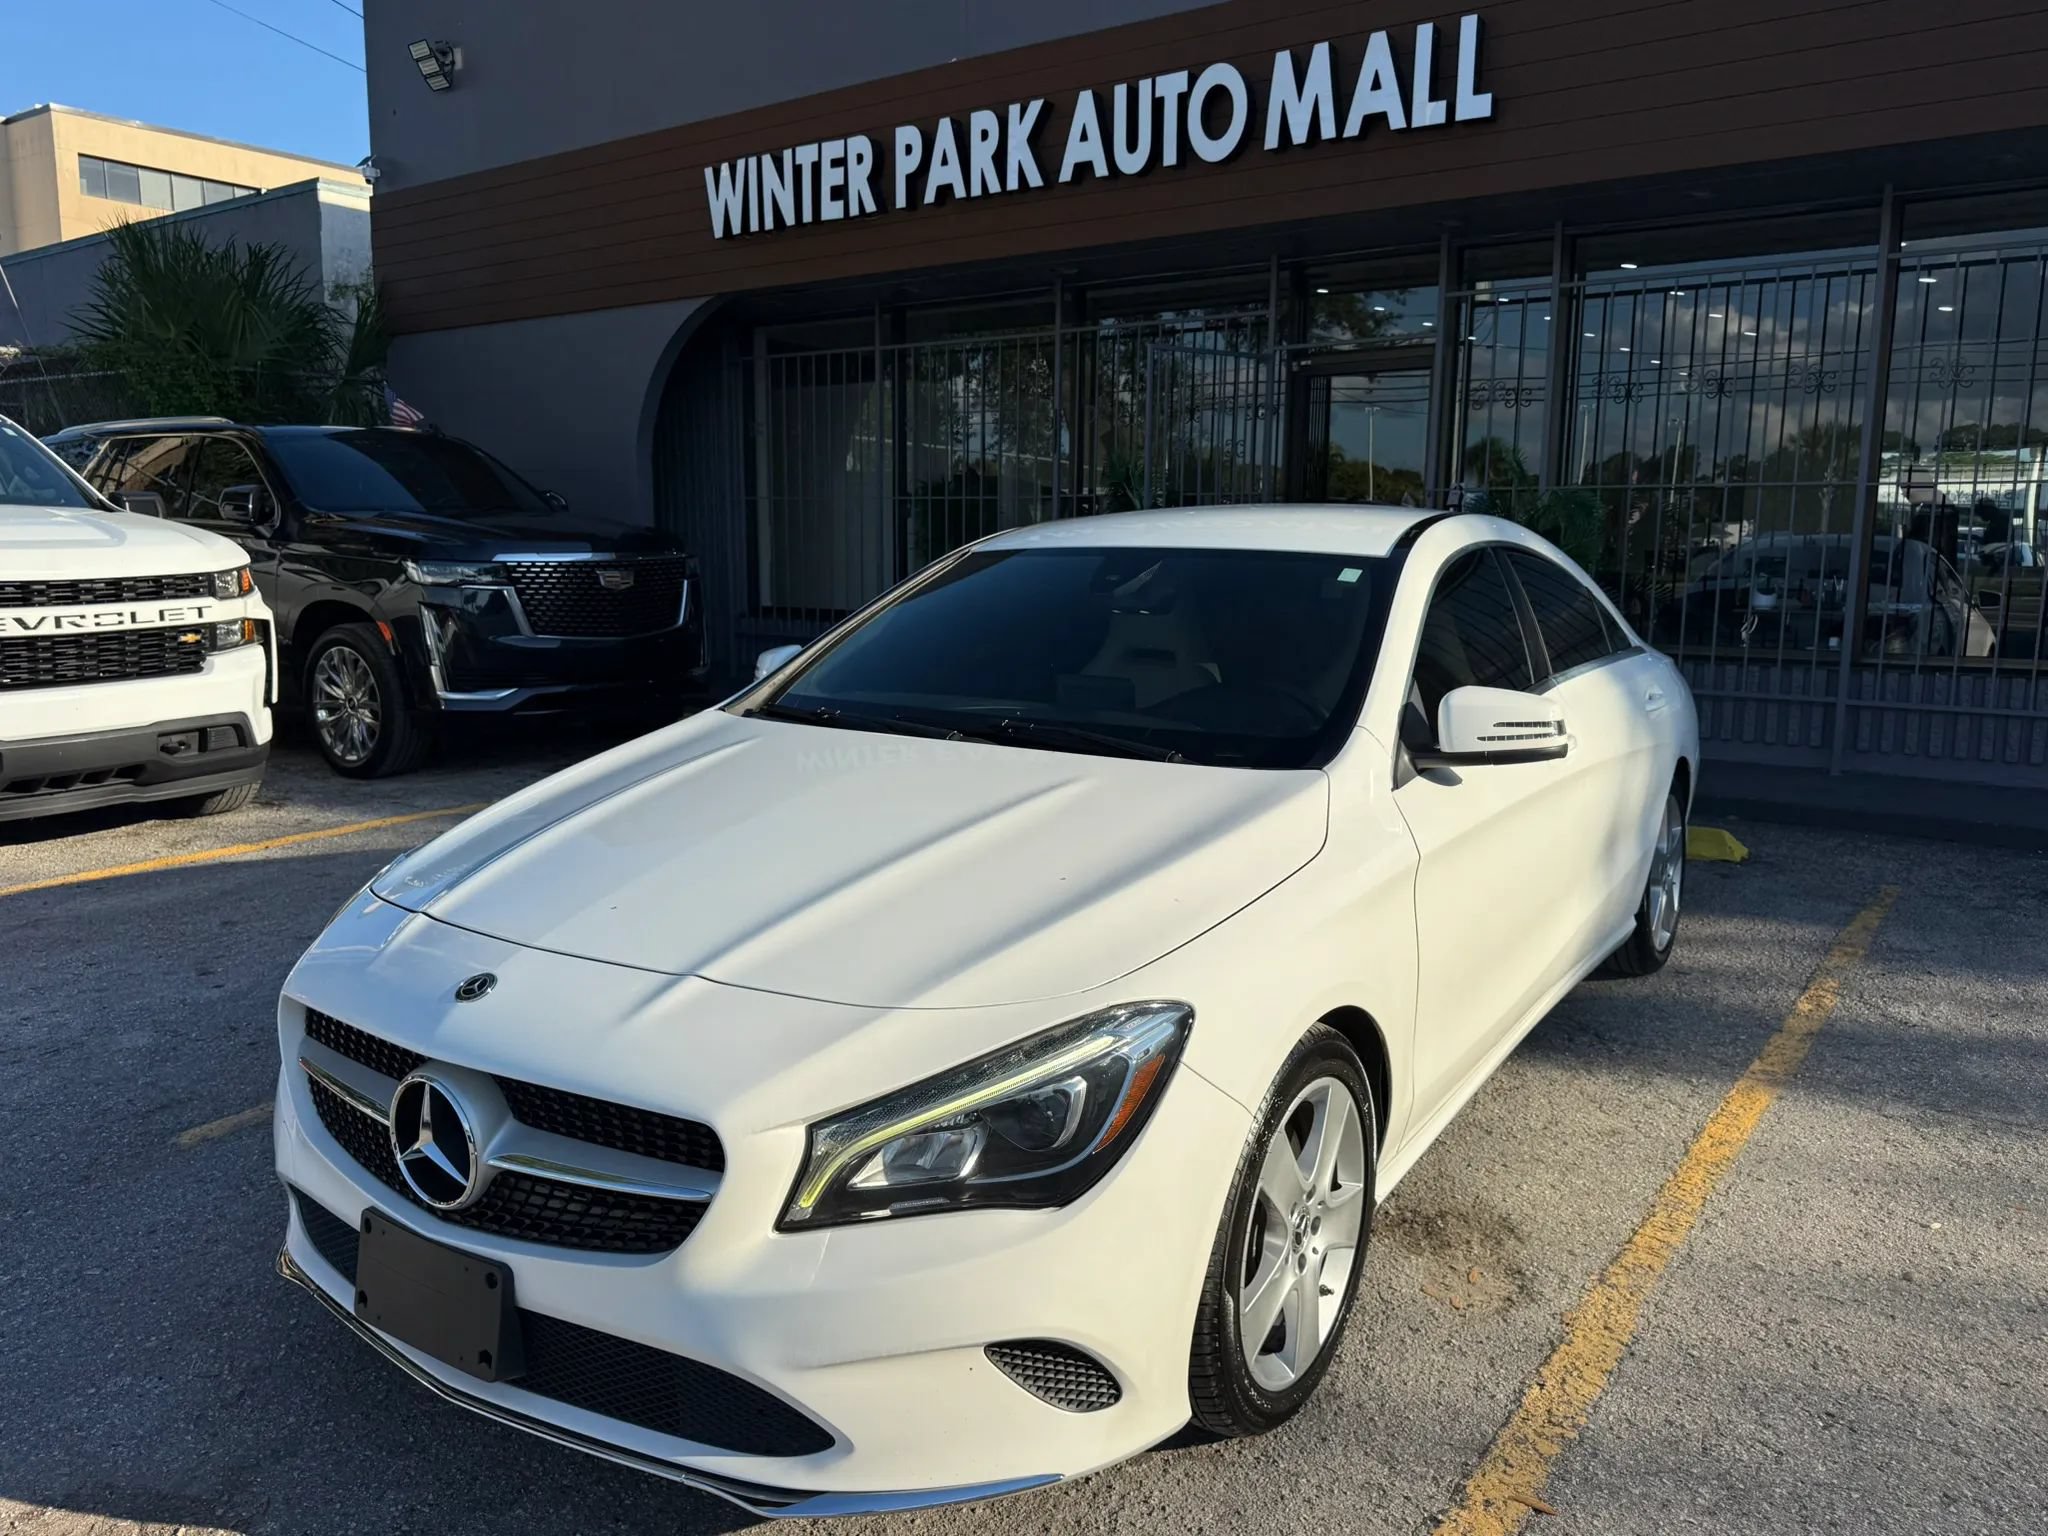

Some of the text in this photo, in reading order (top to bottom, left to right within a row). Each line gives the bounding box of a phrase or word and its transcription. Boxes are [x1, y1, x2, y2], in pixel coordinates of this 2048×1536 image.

[704, 14, 1492, 239] WINTER PARK AUTO MALL
[0, 606, 212, 632] VROLET
